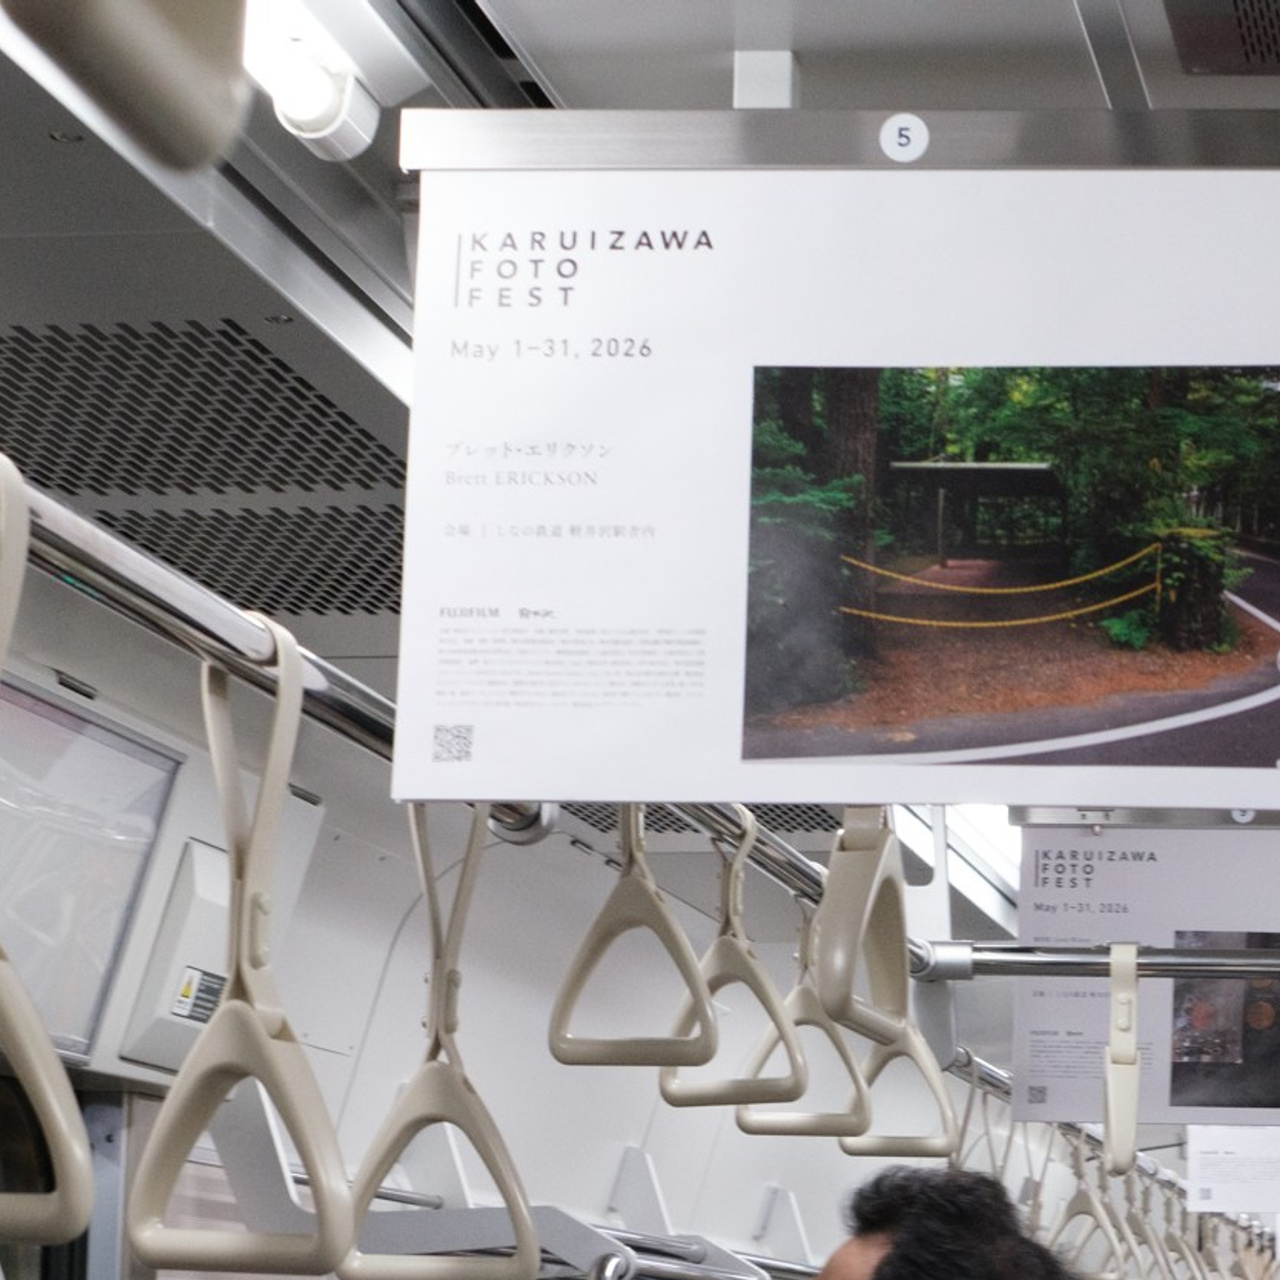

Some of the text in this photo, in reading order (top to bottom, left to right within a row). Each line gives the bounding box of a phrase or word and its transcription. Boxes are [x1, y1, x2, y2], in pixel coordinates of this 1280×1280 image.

[897, 127, 911, 148] 5
[470, 229, 714, 253] KARUIZAWA
[468, 257, 579, 281] FOTO
[467, 285, 576, 308] FEST
[450, 339, 499, 362] May
[590, 337, 653, 358] 2026
[444, 470, 599, 487] Brett ERICKSON
[439, 607, 501, 619] FUJIFILM
[1041, 849, 1158, 863] KARUIZAWA
[1041, 863, 1095, 876] FOTO
[1041, 876, 1093, 889] FEST
[1033, 902, 1059, 915] May
[1098, 902, 1130, 914] 2026
